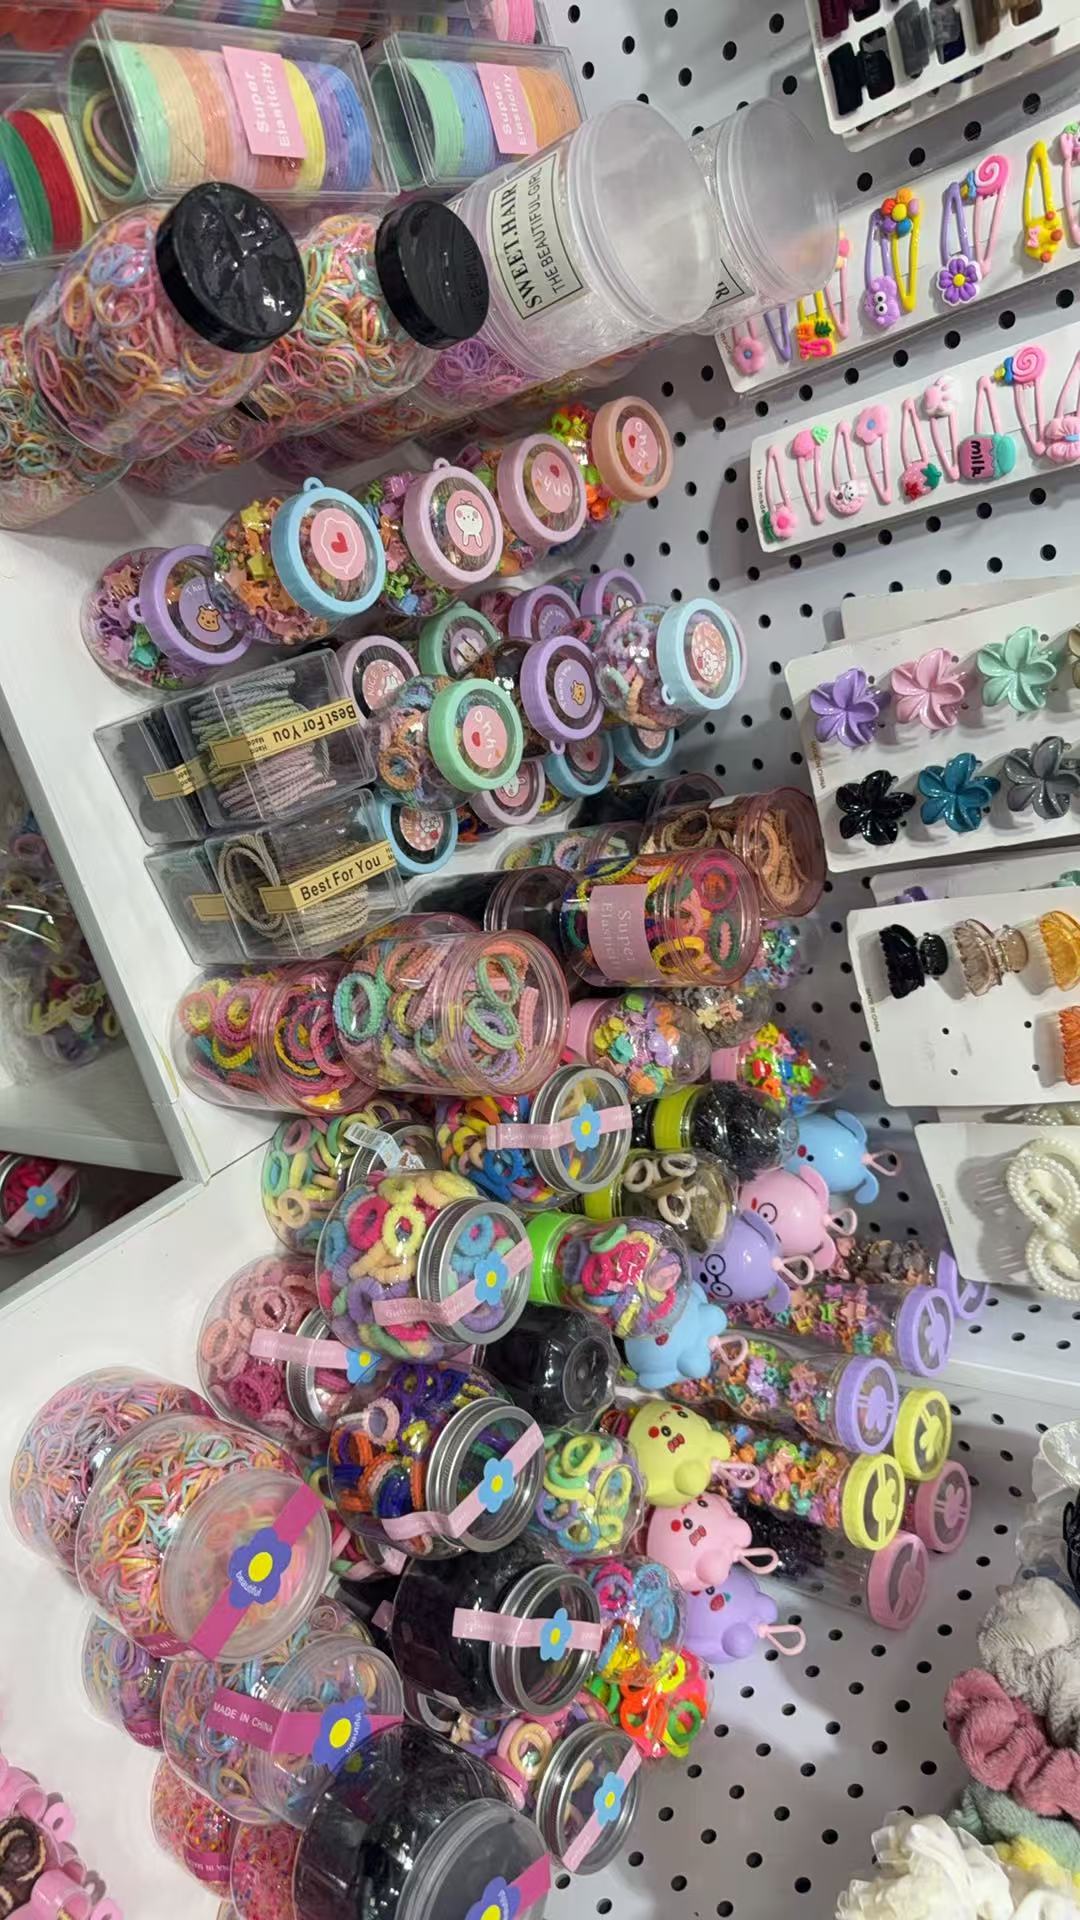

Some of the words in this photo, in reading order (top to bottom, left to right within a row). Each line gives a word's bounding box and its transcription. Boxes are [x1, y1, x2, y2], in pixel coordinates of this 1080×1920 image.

[244, 71, 270, 133] Super
[259, 59, 291, 147] Elasticity
[492, 80, 512, 135] Super
[503, 72, 527, 145] Elasticity
[528, 167, 543, 196] GIRL
[528, 193, 554, 268] BEAUTIFUL
[544, 268, 567, 294] THE
[970, 440, 986, 478] milk
[303, 715, 326, 733] For
[326, 704, 357, 726] Best
[272, 725, 302, 743] You
[300, 877, 332, 901] Best
[332, 867, 353, 886] For
[355, 855, 381, 874] You
[236, 1570, 262, 1597] beautiful
[213, 1701, 239, 1719] MADE
[239, 1712, 250, 1723] IN
[251, 1717, 274, 1735] CHINA
